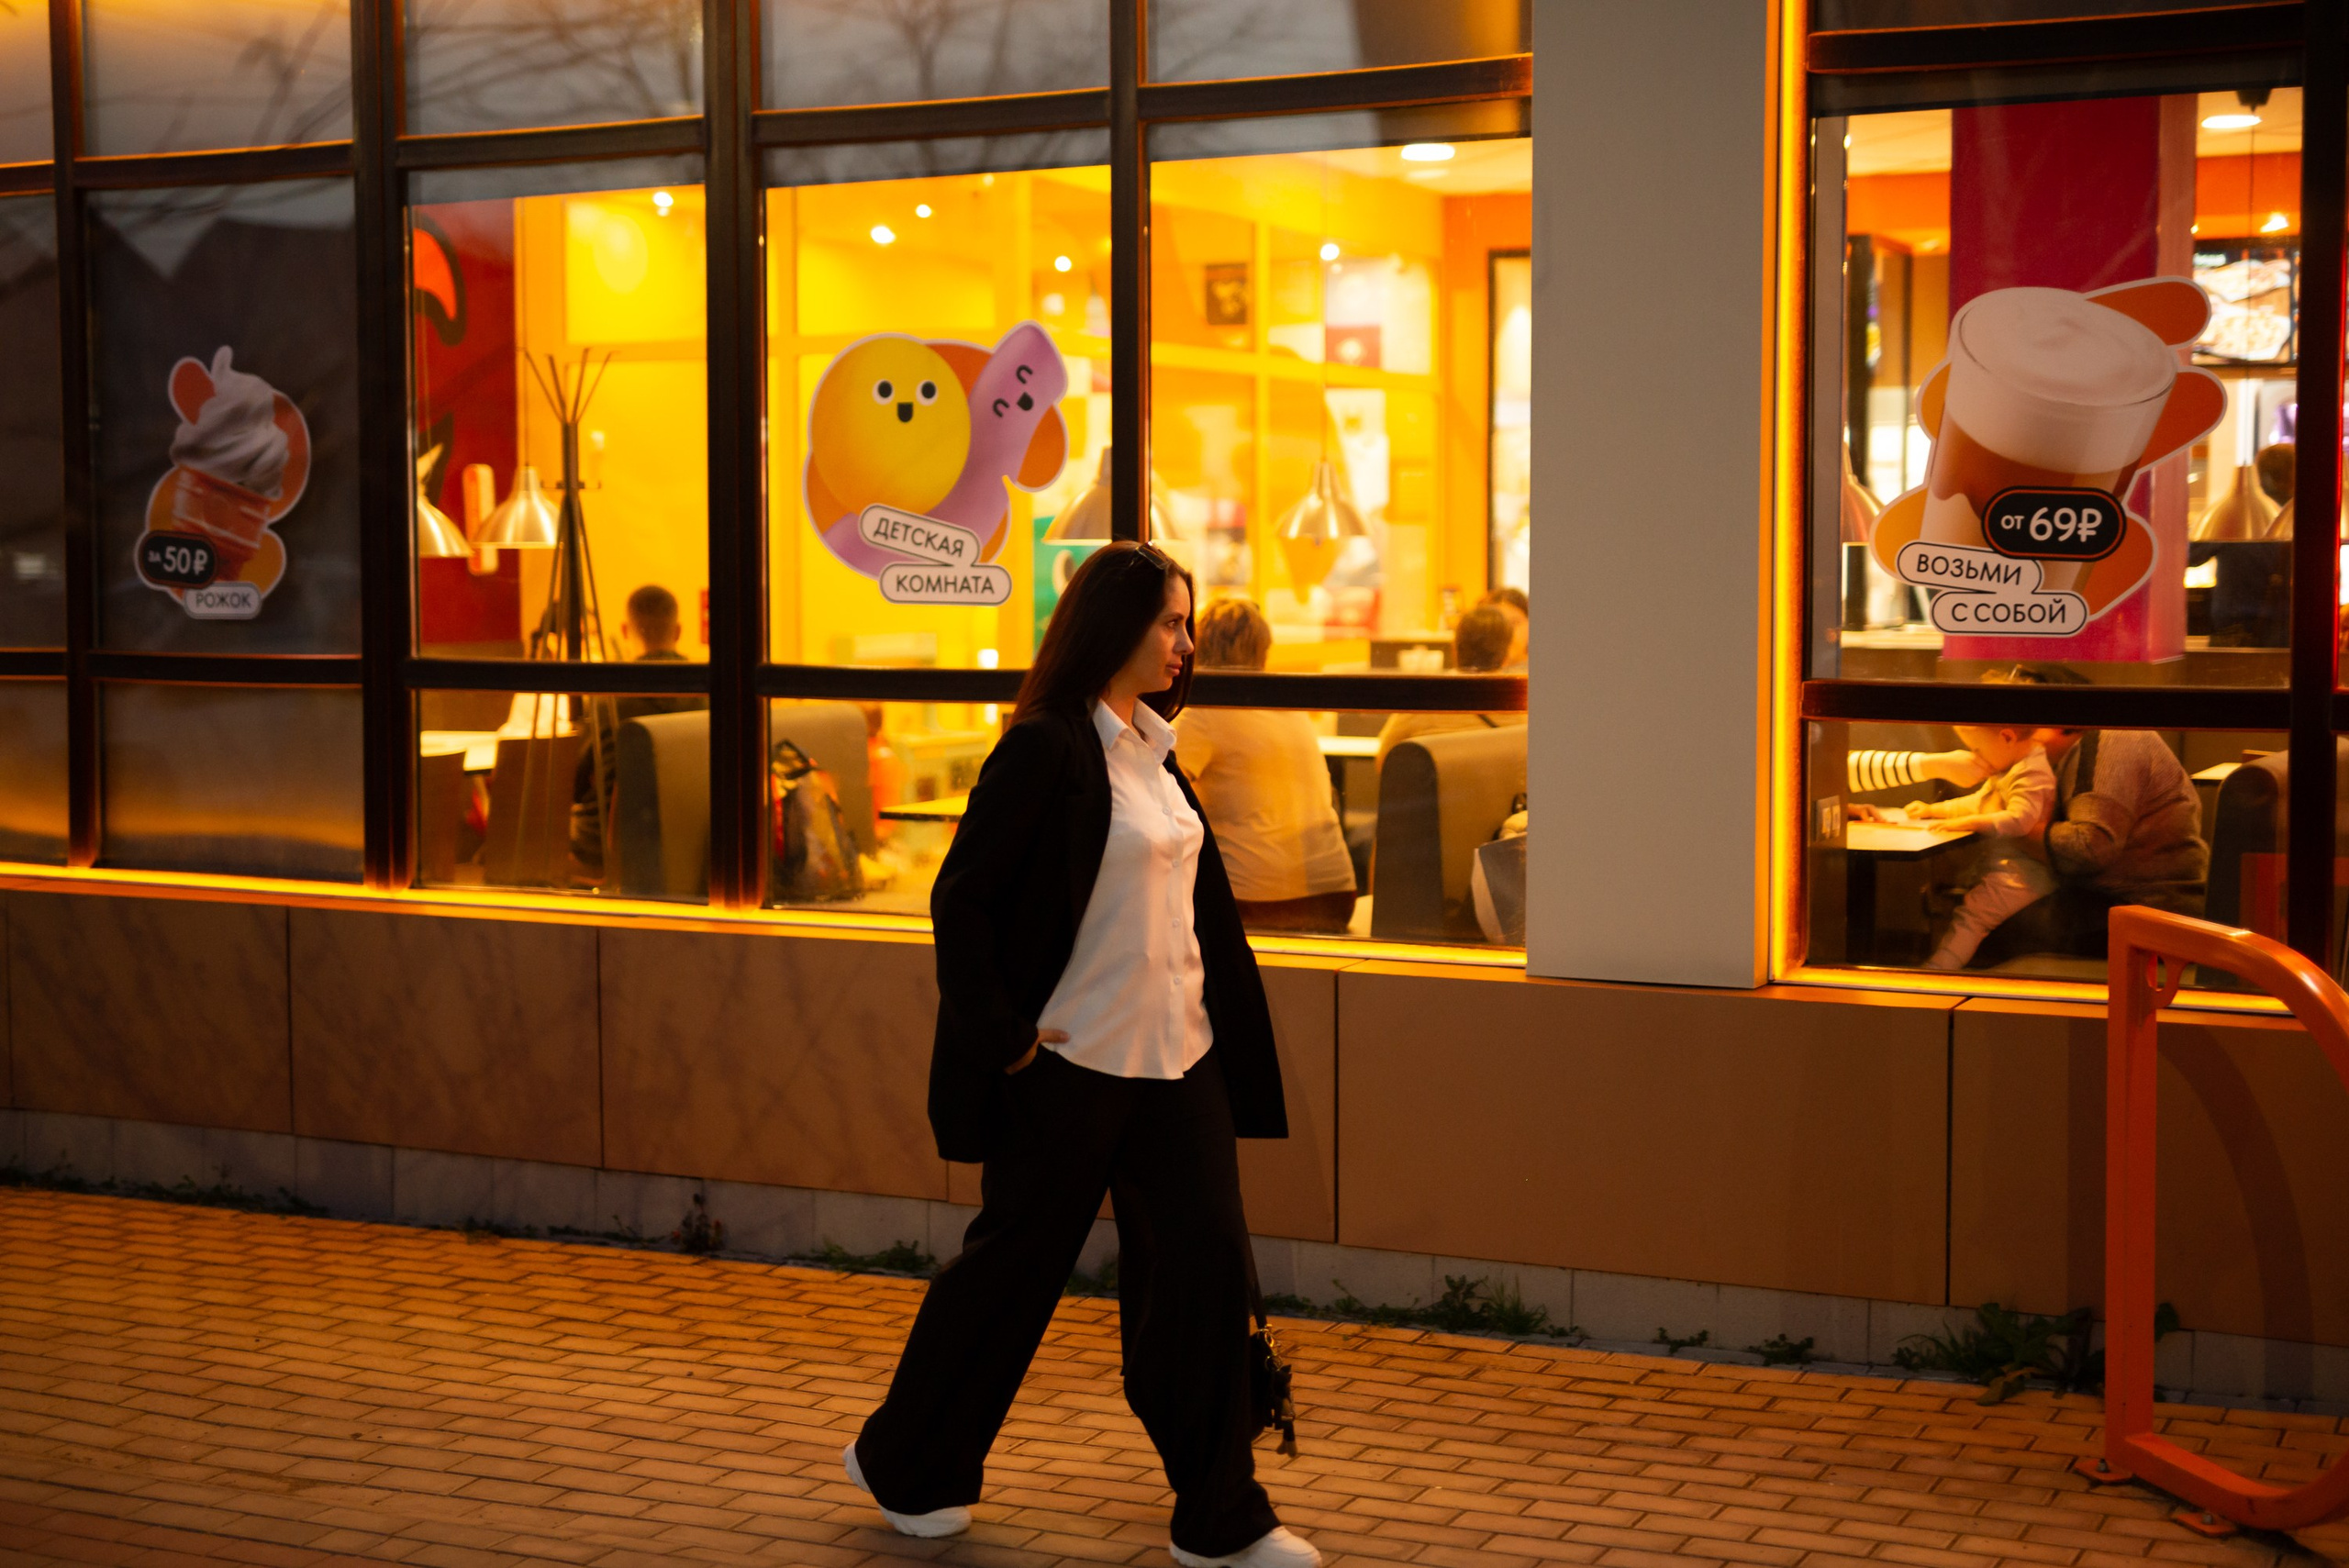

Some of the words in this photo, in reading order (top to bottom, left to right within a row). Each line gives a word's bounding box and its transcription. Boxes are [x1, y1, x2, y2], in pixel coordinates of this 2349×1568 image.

[873, 517, 965, 559] ДЕТСКАЯ
[2029, 506, 2103, 543] 69₽
[896, 573, 996, 595] КОМНАТА
[1916, 553, 2022, 586] ВОЗЬМИ
[195, 591, 251, 608] РОЖОК
[1951, 602, 1969, 623] С
[1974, 597, 2066, 624] СОБОЙ
